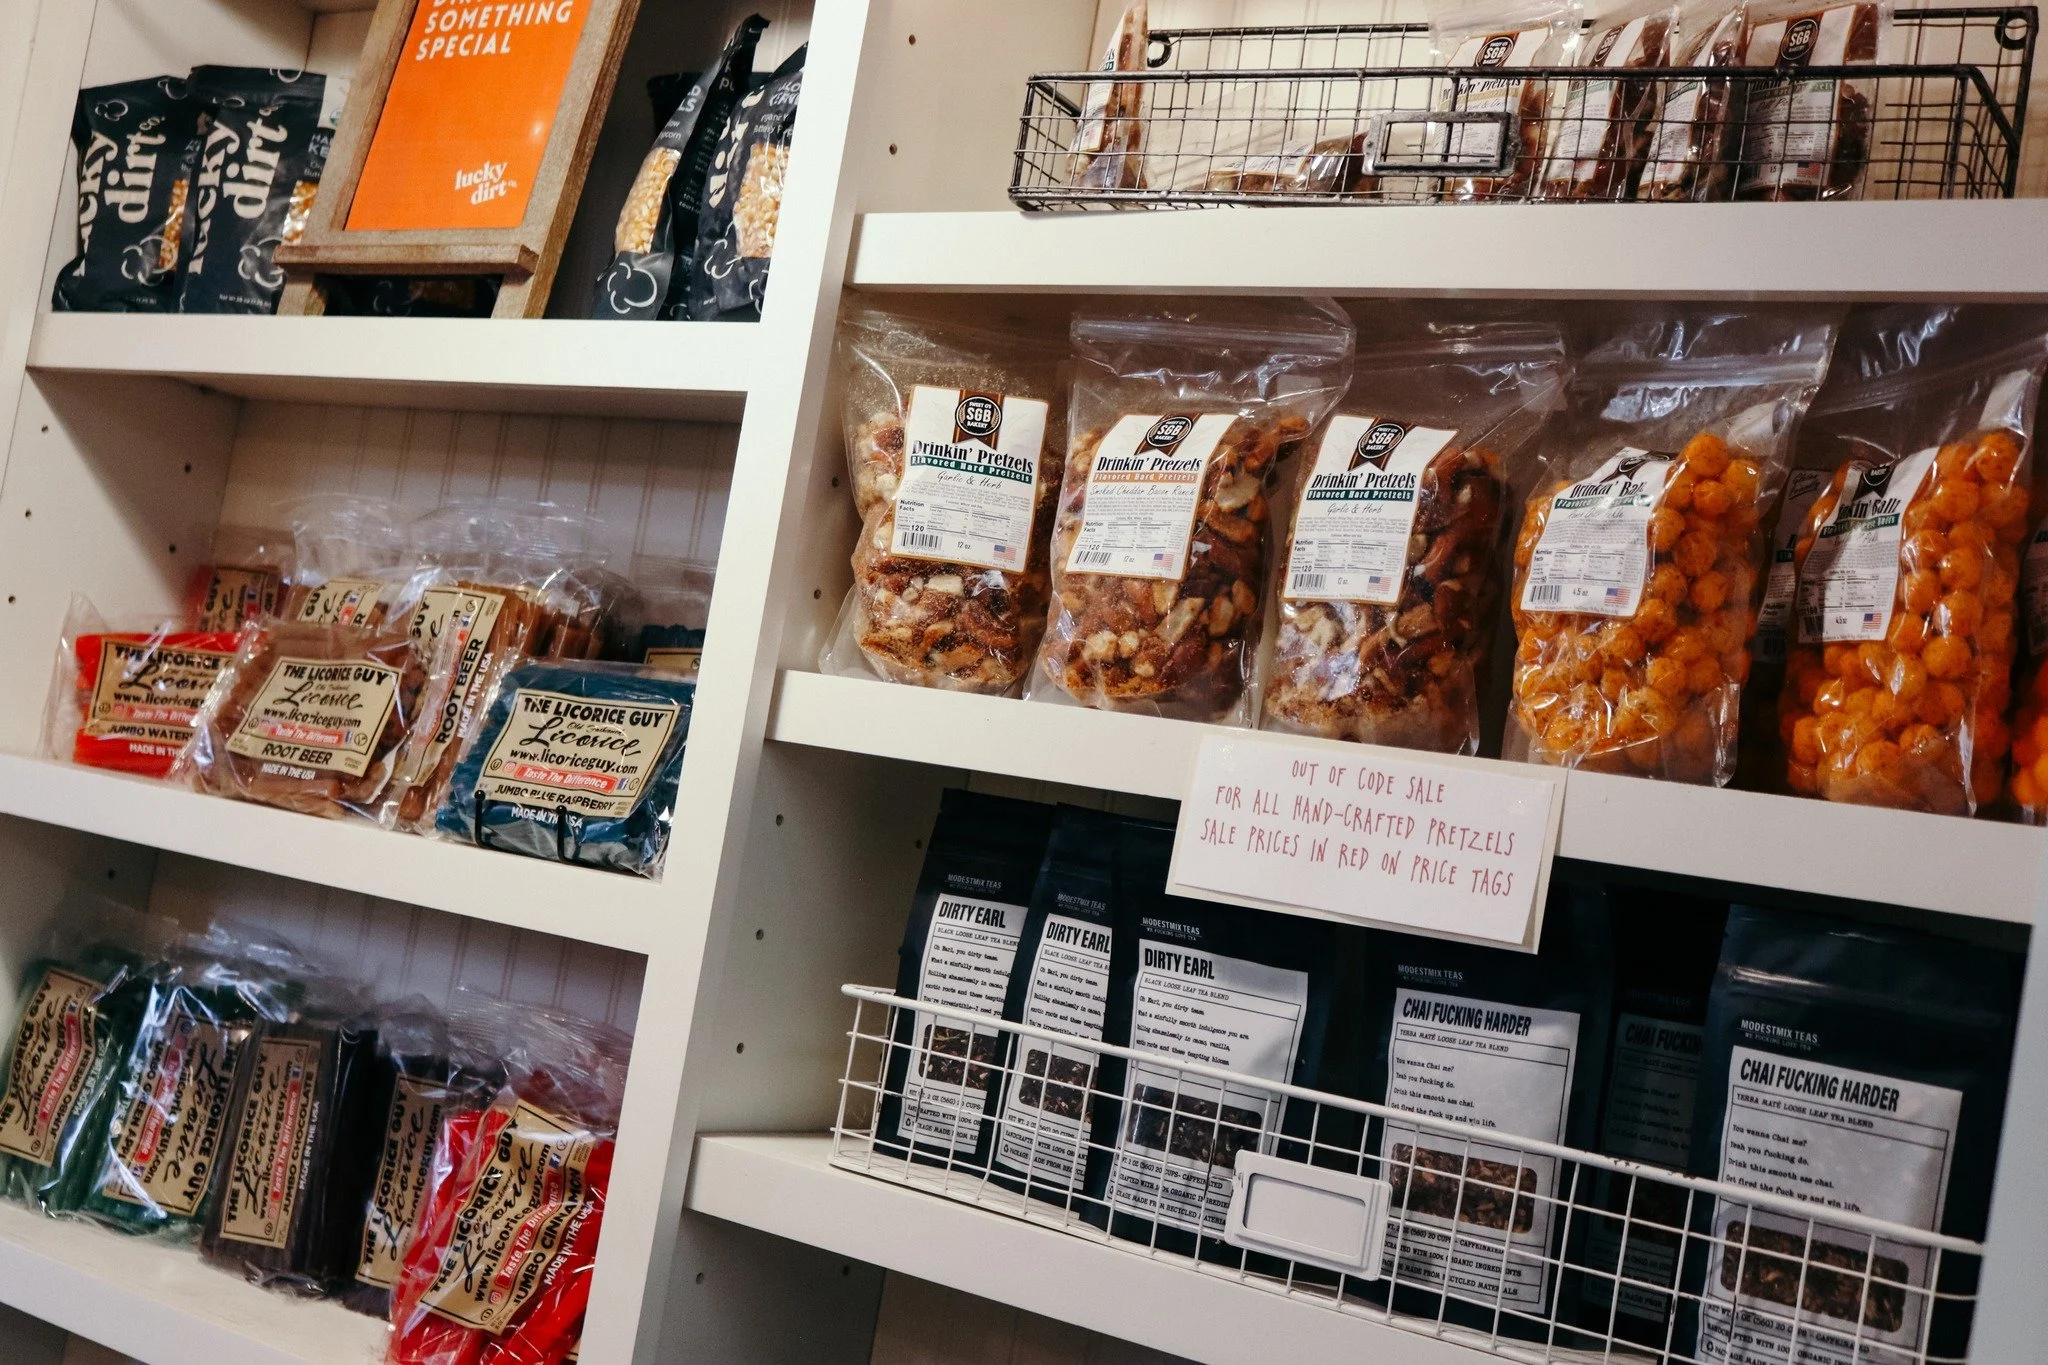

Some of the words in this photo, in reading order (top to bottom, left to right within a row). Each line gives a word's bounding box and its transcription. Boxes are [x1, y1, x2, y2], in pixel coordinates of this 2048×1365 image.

[425, 1, 573, 34] SOMETHING
[416, 31, 511, 61] SPECIAL
[1790, 32, 1810, 46] SGB
[1484, 48, 1506, 59] SGB
[104, 131, 166, 223] dirt
[223, 118, 287, 219] dirt
[455, 161, 508, 190] lucky
[471, 181, 508, 205] dirt
[966, 407, 992, 423] SGB
[1157, 425, 1183, 435] SGB
[1368, 433, 1394, 445] SGB
[912, 440, 972, 461] Drinkin'
[977, 449, 1033, 474] Pretzels
[912, 456, 955, 468] Flavored
[960, 461, 984, 473] Hard
[989, 466, 1030, 482] Pretzels
[1097, 457, 1149, 471] Drinkin'
[1150, 458, 1202, 472] Pretzels
[938, 471, 964, 485] Garlic
[967, 475, 974, 485] &
[980, 475, 1002, 489] Herb
[1095, 473, 1130, 481] Flavored
[1134, 473, 1154, 481] Hard
[1311, 473, 1363, 488] Drinkin'
[1365, 473, 1416, 489] Pretzels
[1090, 486, 1114, 495] Smoked
[1117, 486, 1145, 495] Cheddar
[1148, 486, 1168, 495] Bacon
[1172, 486, 1195, 496] Ranch
[1308, 490, 1345, 499] Flavored
[1373, 491, 1411, 500] Pretzels
[1328, 503, 1349, 515] Garlic
[1351, 505, 1357, 513] &
[1363, 504, 1382, 513] Herb
[284, 665, 306, 678] THE
[308, 666, 351, 681] LICORICE
[353, 669, 388, 685] GUY
[273, 681, 363, 710] Licorice
[435, 692, 462, 744] ROOT
[457, 639, 483, 687] BEER
[458, 703, 473, 738] MADE
[472, 673, 485, 694] THE
[481, 653, 494, 673] USA
[264, 707, 361, 729] www.licoriceguy.com
[524, 698, 552, 714] THE
[553, 702, 626, 724] LICORICE
[629, 711, 664, 727] GUY
[108, 724, 145, 736] JUMBO
[305, 729, 338, 744] Difference
[519, 717, 641, 756] Licorice
[262, 743, 299, 759] ROOT
[300, 751, 332, 765] BEER
[510, 749, 638, 774] www.licoriceguy.com
[261, 764, 281, 775] MADE
[287, 767, 301, 778] THE
[301, 770, 315, 780] USA
[524, 768, 545, 780] Taste
[547, 772, 563, 783] The
[565, 774, 608, 789] Difference
[1292, 760, 1319, 786] OUT
[1328, 767, 1347, 786] OF
[1358, 767, 1395, 796] CODE
[1405, 776, 1445, 805] SALE
[495, 784, 528, 797] JUMBO
[530, 789, 554, 802] BLUE
[556, 794, 613, 811] RASPBERRY
[511, 807, 532, 819] MADE
[1215, 785, 1241, 811] FOR
[1253, 789, 1279, 817] ALL
[1293, 795, 1416, 841] HAND-CRAFTED
[1426, 818, 1516, 857] PRETZELS
[1200, 818, 1236, 845] SALE
[1247, 828, 1300, 858] PRICES
[1310, 838, 1329, 864] IN
[1338, 843, 1369, 871] RED
[1381, 850, 1400, 876] ON
[1411, 855, 1458, 886] PRICE
[1472, 868, 1514, 897] TAGS
[939, 902, 976, 922] DIRTY
[975, 908, 1006, 928] EARL
[1142, 917, 1182, 931] MODESTMIX
[1182, 925, 1200, 935] TEAS
[1047, 922, 1082, 944] DIRTY
[1081, 933, 1110, 953] EARL
[1145, 948, 1183, 972] DIRTY
[1184, 956, 1215, 979] EARL
[1398, 965, 1442, 978] MODESTMIX
[1444, 970, 1463, 980] TEAS
[1403, 998, 1431, 1019] CHAI
[1432, 1003, 1482, 1029] FUCKING
[1484, 1011, 1532, 1036] HARDER
[1741, 1019, 1792, 1038] MODESTMIX
[1795, 1031, 1818, 1044] TEAS
[1396, 1057, 1405, 1065] You
[1407, 1060, 1424, 1068] wanna
[1427, 1062, 1440, 1070] Chai
[1419, 1077, 1444, 1088] fucking
[1740, 1059, 1775, 1086] CHAI
[1776, 1067, 1838, 1100] FUCKING
[1840, 1081, 1900, 1112] HARDER
[1394, 1088, 1408, 1096] Drink
[1409, 1091, 1421, 1099] this
[1423, 1093, 1445, 1103] smooth
[1447, 1098, 1458, 1107] ass
[1459, 1100, 1474, 1108] chai.
[312, 1101, 320, 1123] USA
[228, 1188, 240, 1222] THE
[234, 1100, 257, 1182] LICORICE
[253, 1053, 267, 1093] GUY
[244, 1066, 280, 1216] Licorice
[283, 1165, 296, 1216] JUMBO
[292, 1072, 313, 1161] CHOCOLATE
[307, 1125, 316, 1147] THE
[305, 1149, 311, 1158] IN
[300, 1161, 310, 1189] MADE
[430, 1259, 457, 1292] THE
[452, 1167, 501, 1252] LICORICE
[498, 1119, 518, 1163] GUY
[463, 1143, 533, 1293] Licorice
[475, 1144, 550, 1302] www.licoriceguy.com
[501, 1251, 523, 1278] Taste
[517, 1231, 532, 1254] The
[528, 1182, 560, 1228] Difference
[514, 1253, 547, 1306] JUMBO
[542, 1168, 581, 1249] CINNAMON
[544, 1257, 566, 1285] MADE
[561, 1242, 573, 1256] IN
[568, 1221, 582, 1243] THE
[580, 1201, 594, 1220] USA
